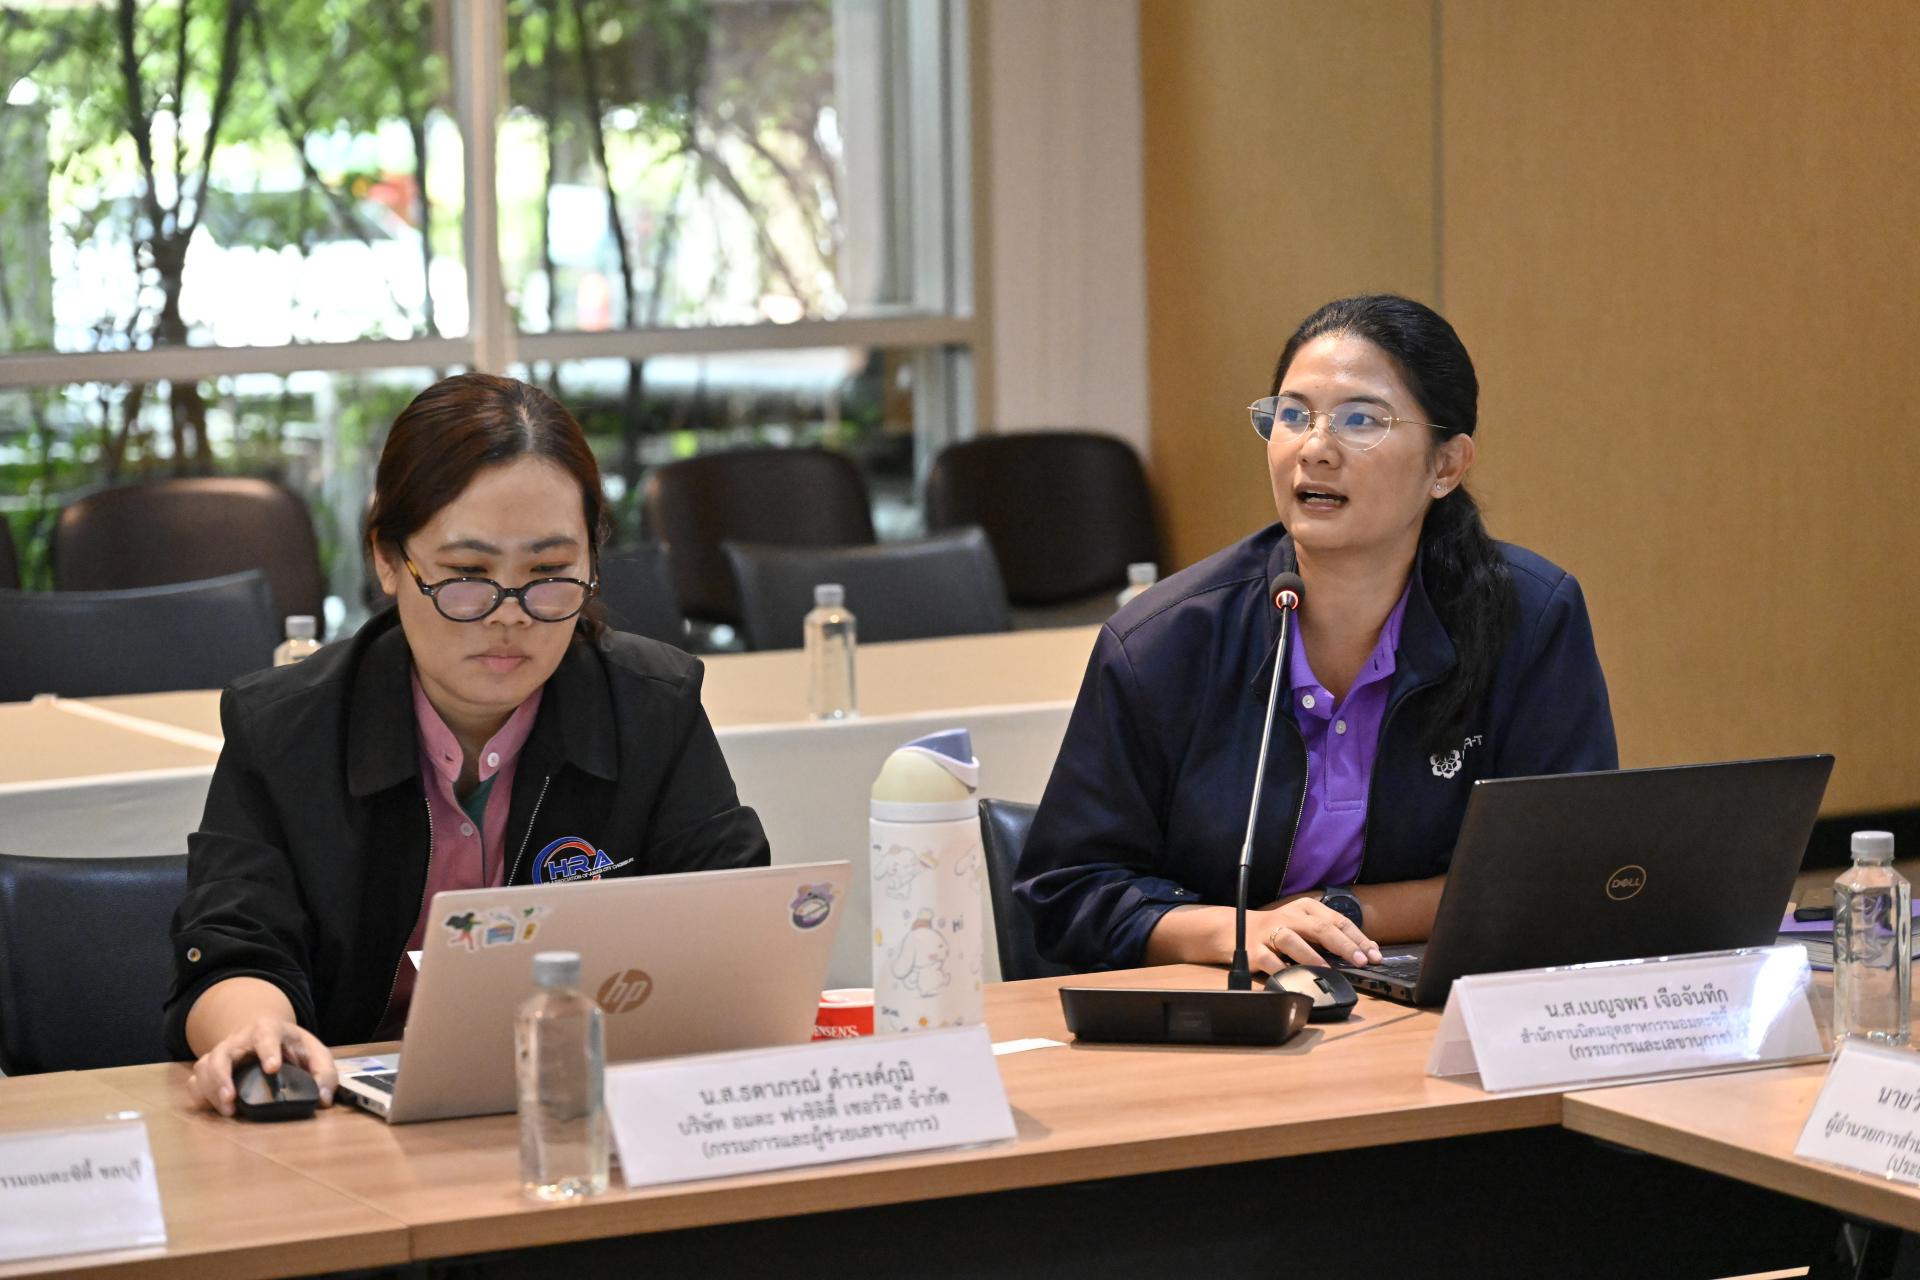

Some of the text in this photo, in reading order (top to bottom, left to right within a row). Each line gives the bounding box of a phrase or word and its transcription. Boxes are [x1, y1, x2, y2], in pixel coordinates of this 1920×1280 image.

[1611, 878, 1640, 888] DELL
[602, 970, 649, 1012] hp
[1545, 996, 1649, 1019] น.ส.เบญจพร
[678, 1112, 726, 1136] บริษัท
[908, 1086, 950, 1108] จำกัด
